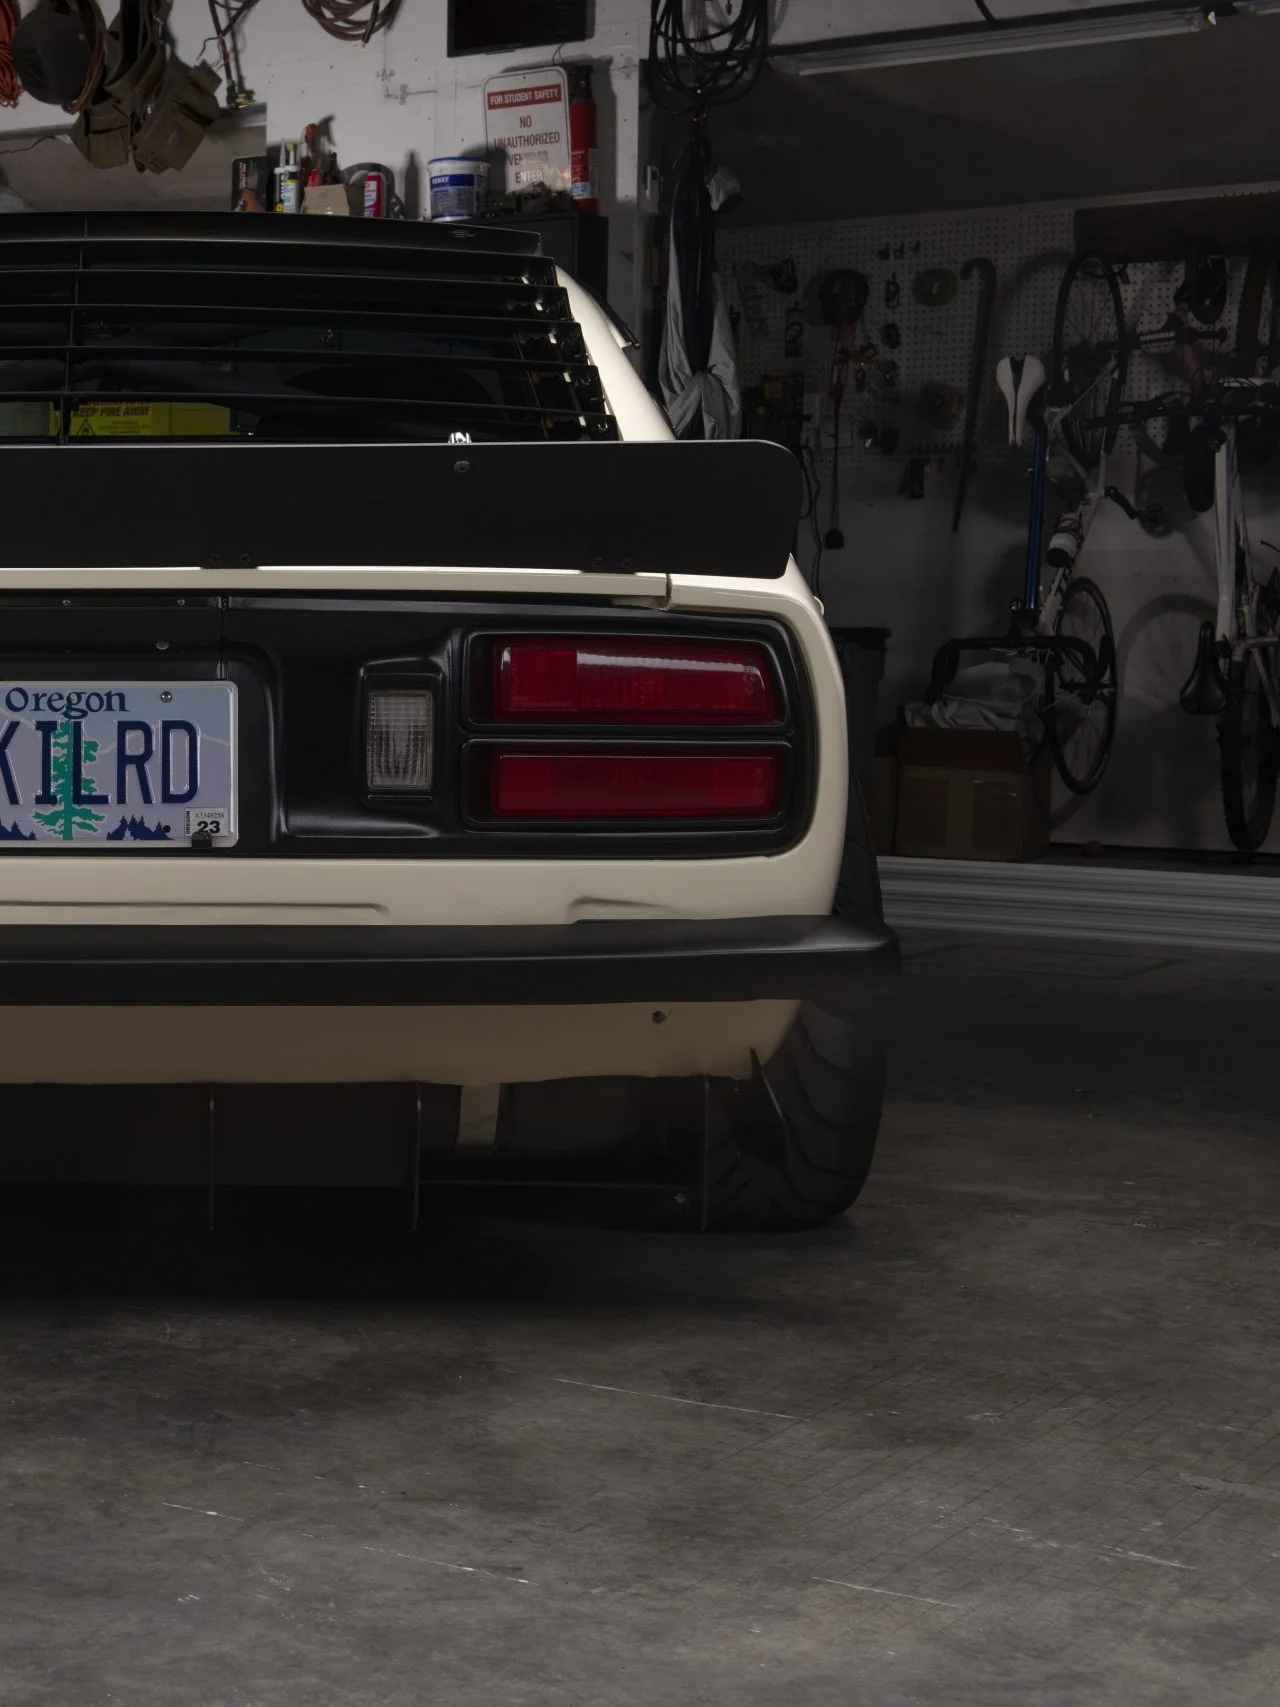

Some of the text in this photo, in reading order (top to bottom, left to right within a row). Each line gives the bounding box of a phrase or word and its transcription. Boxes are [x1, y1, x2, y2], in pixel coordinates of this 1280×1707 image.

[490, 88, 559, 105] FOR STUDENT SAFETY
[519, 115, 532, 128] NO
[494, 131, 561, 149] UNAUTHORIZED
[515, 170, 543, 184] ENTER
[100, 406, 122, 417] FIRE
[123, 405, 152, 417] AWAY
[5, 687, 130, 720] Oregon
[197, 820, 221, 835] 23
